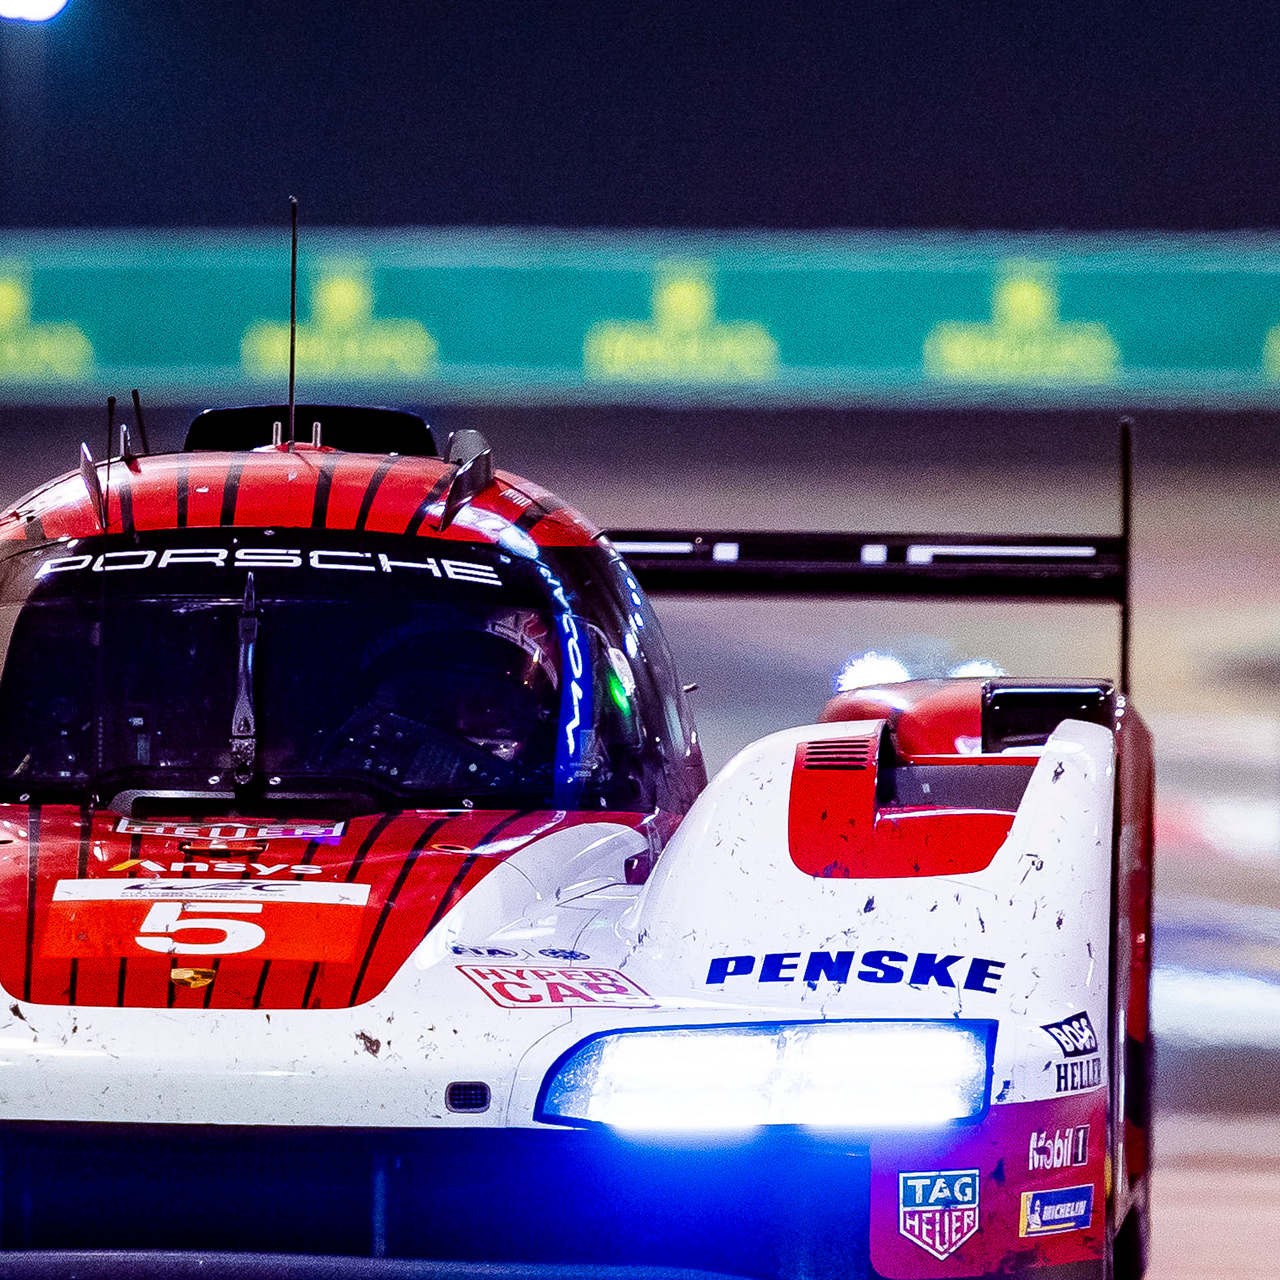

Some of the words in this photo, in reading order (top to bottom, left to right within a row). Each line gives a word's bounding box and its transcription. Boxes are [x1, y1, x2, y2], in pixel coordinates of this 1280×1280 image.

[34, 547, 503, 586] PORSCHE
[107, 859, 323, 876] Ansys
[134, 901, 266, 955] 5
[472, 968, 619, 984] HYPER
[705, 950, 1006, 994] PENSKE
[1028, 1128, 1074, 1171] Mobil
[1077, 1129, 1086, 1162] 1
[906, 1176, 973, 1204] TAG
[1041, 1200, 1088, 1221] MICHELIN
[905, 1210, 974, 1253] HEUER
